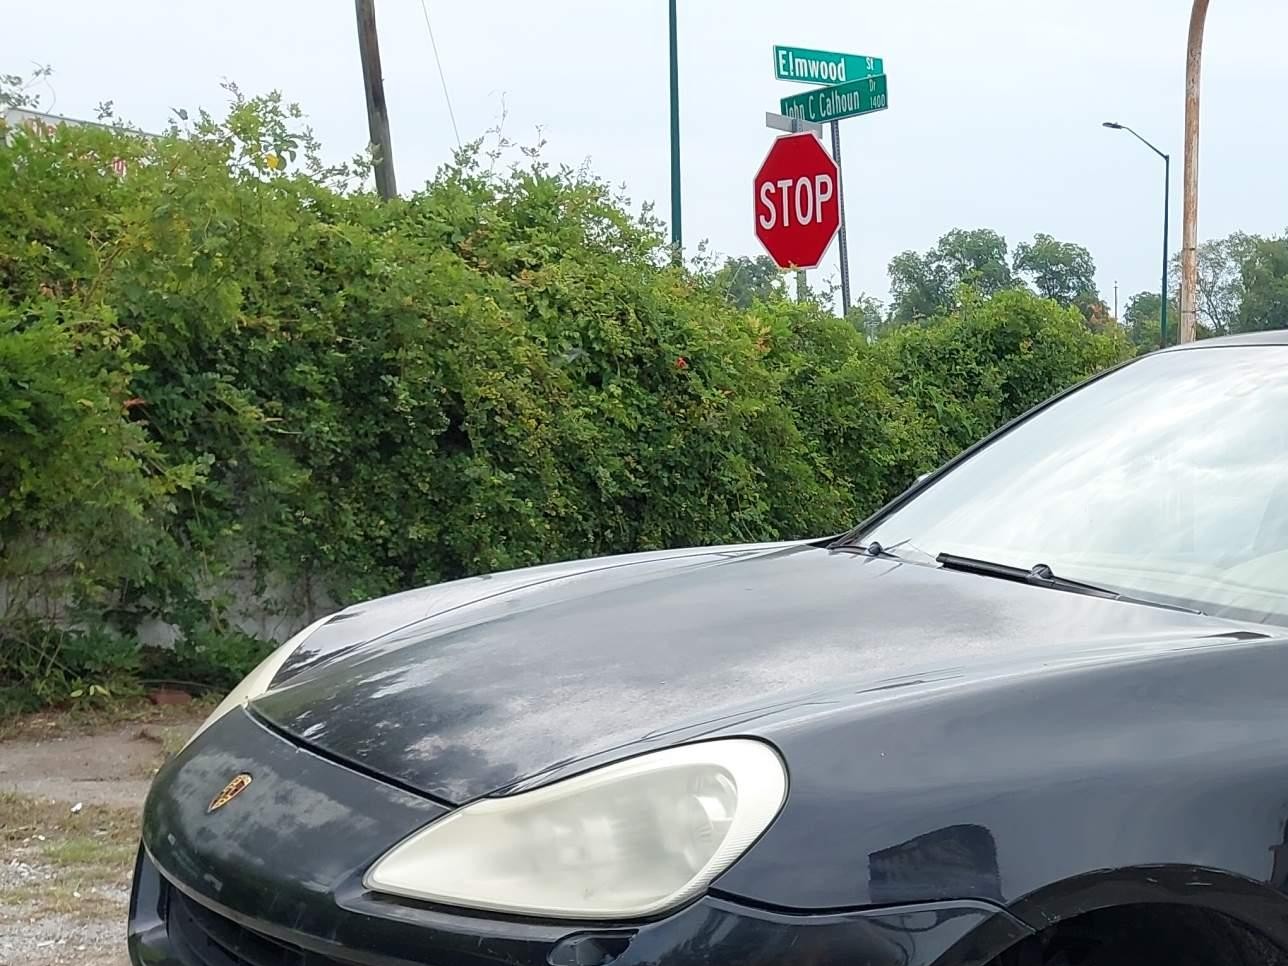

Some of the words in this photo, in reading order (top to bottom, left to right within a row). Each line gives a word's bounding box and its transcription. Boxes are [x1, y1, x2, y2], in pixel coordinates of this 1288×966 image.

[778, 49, 846, 82] Elmwood
[865, 56, 874, 71] St
[808, 95, 816, 120] C
[819, 89, 860, 118] Calhoun
[869, 78, 876, 92] Dr
[759, 173, 833, 231] STOP
